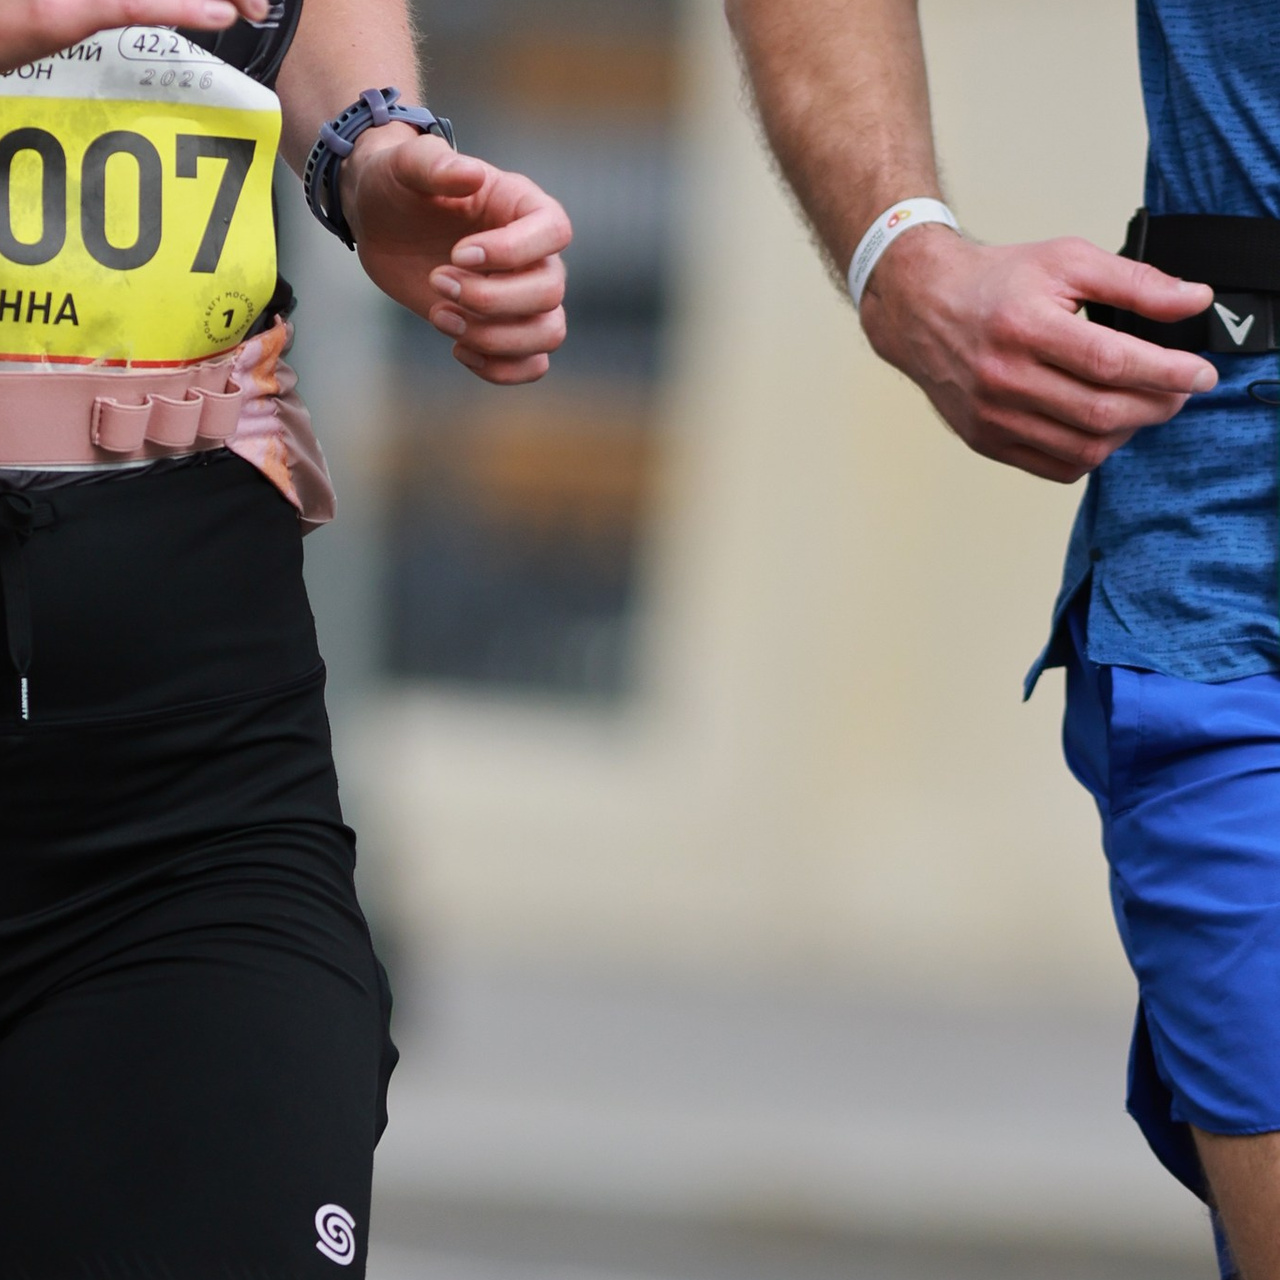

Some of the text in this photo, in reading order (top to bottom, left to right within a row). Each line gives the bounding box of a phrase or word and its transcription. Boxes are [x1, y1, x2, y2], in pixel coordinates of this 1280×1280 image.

[132, 33, 180, 57] 42,2
[138, 68, 214, 90] 2026
[222, 309, 235, 329] 1
